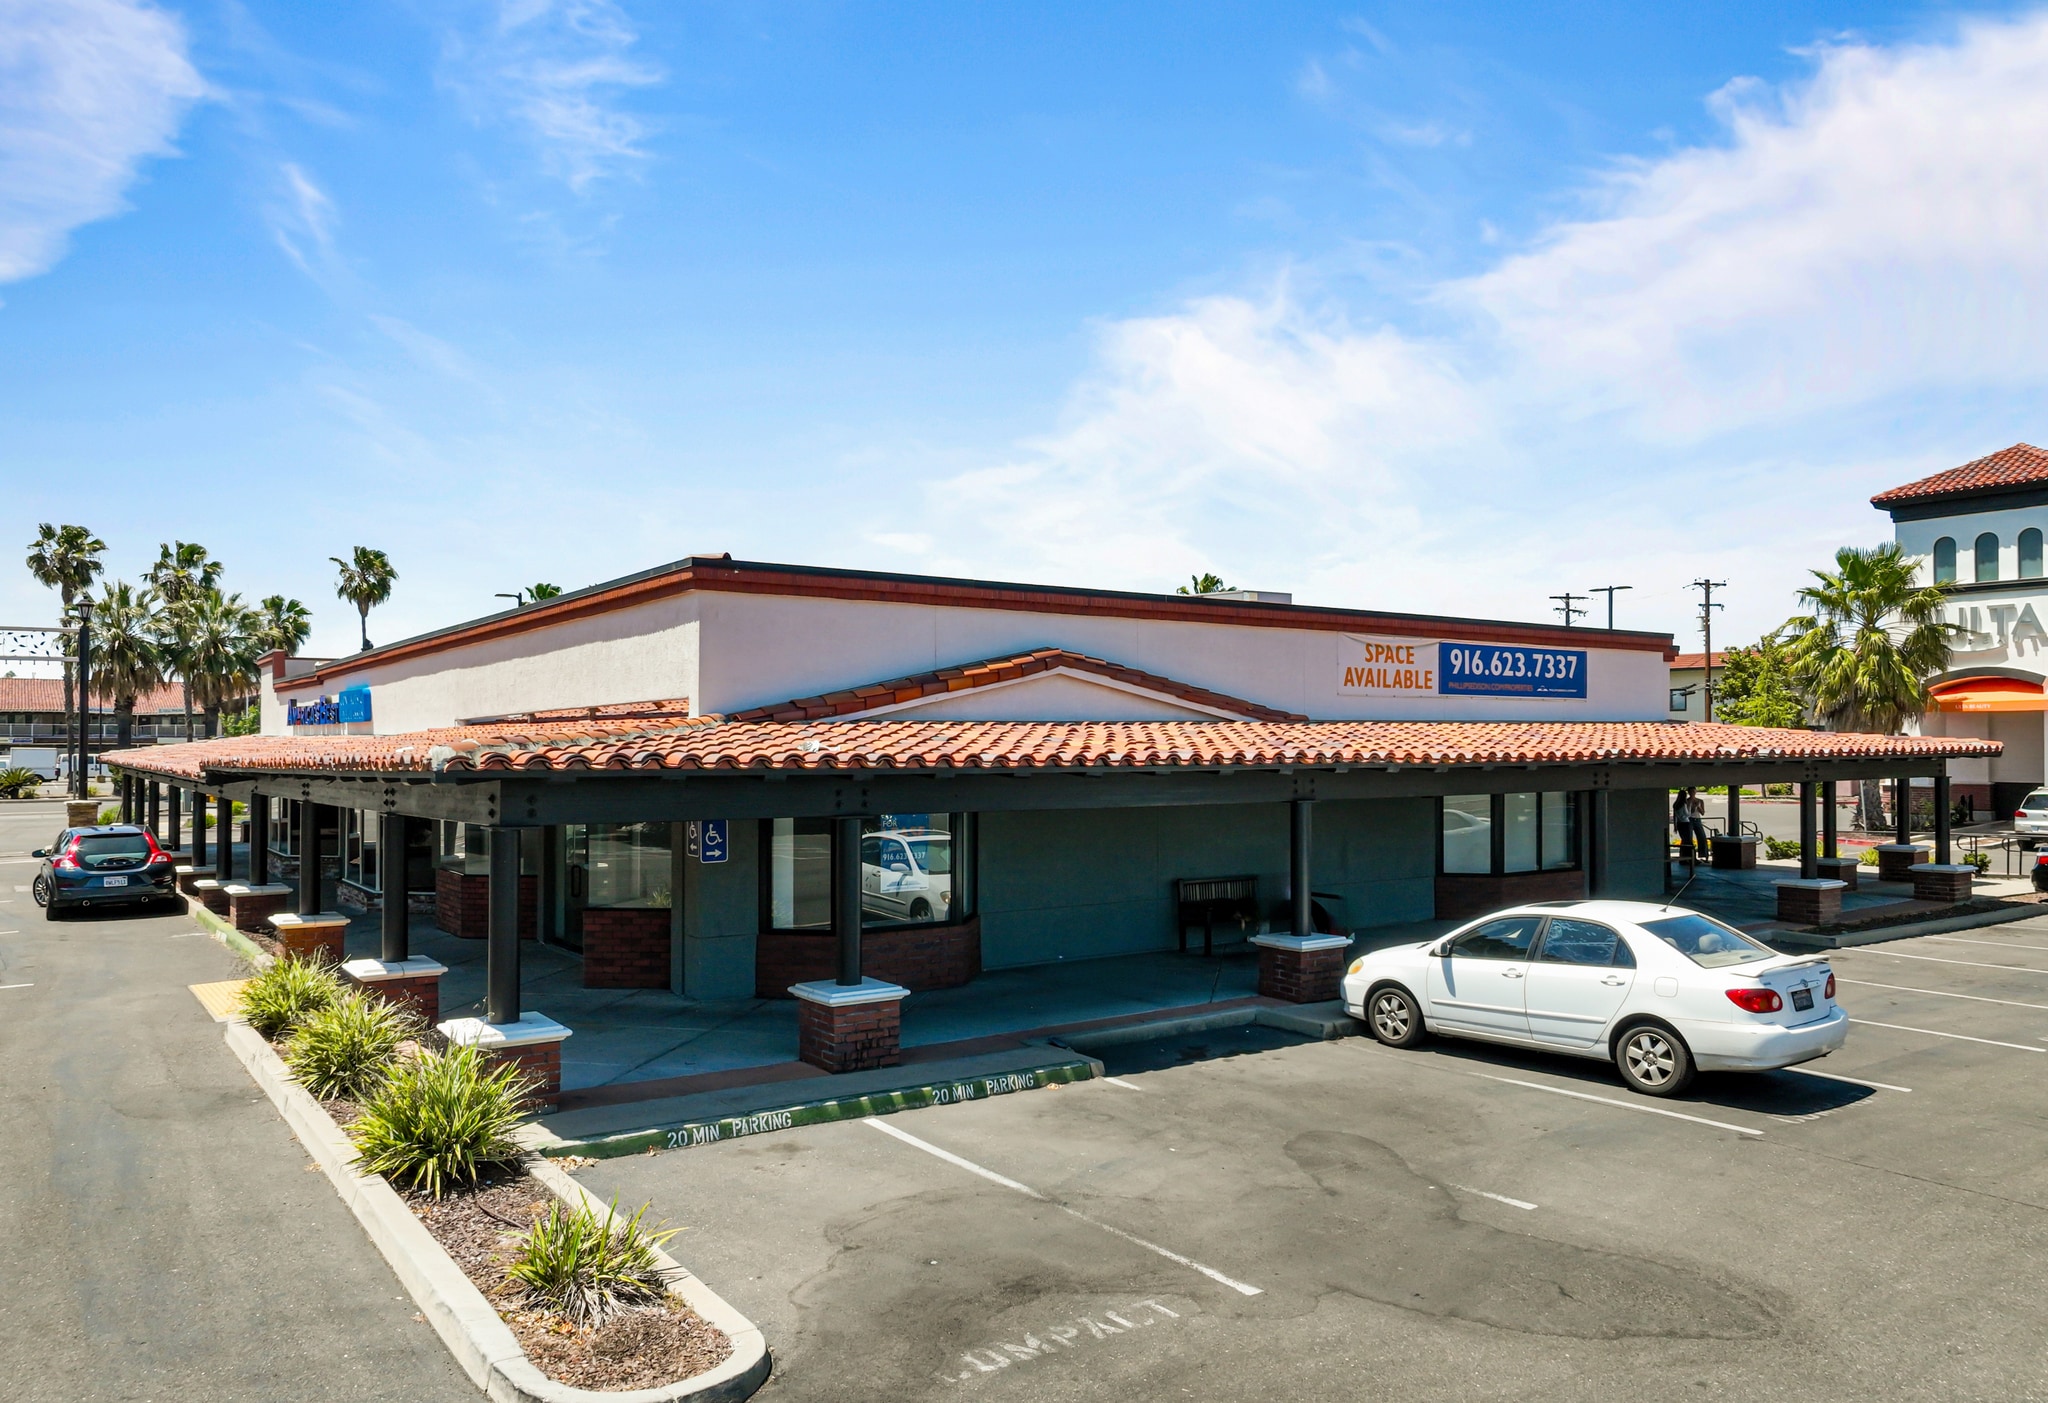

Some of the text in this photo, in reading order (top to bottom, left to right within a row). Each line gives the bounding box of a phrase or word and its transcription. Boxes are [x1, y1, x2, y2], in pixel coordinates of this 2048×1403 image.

[1936, 602, 2048, 642] ULTA
[1365, 642, 1415, 665] SPACE
[1450, 648, 1578, 679] 916.623.7337
[1343, 666, 1433, 690] AVAILABLE
[882, 820, 898, 828] FOR
[882, 851, 926, 861] 916.623337
[932, 1073, 1034, 1105] 20 MIN PARKING
[667, 1112, 792, 1149] 20 MIN PARKING
